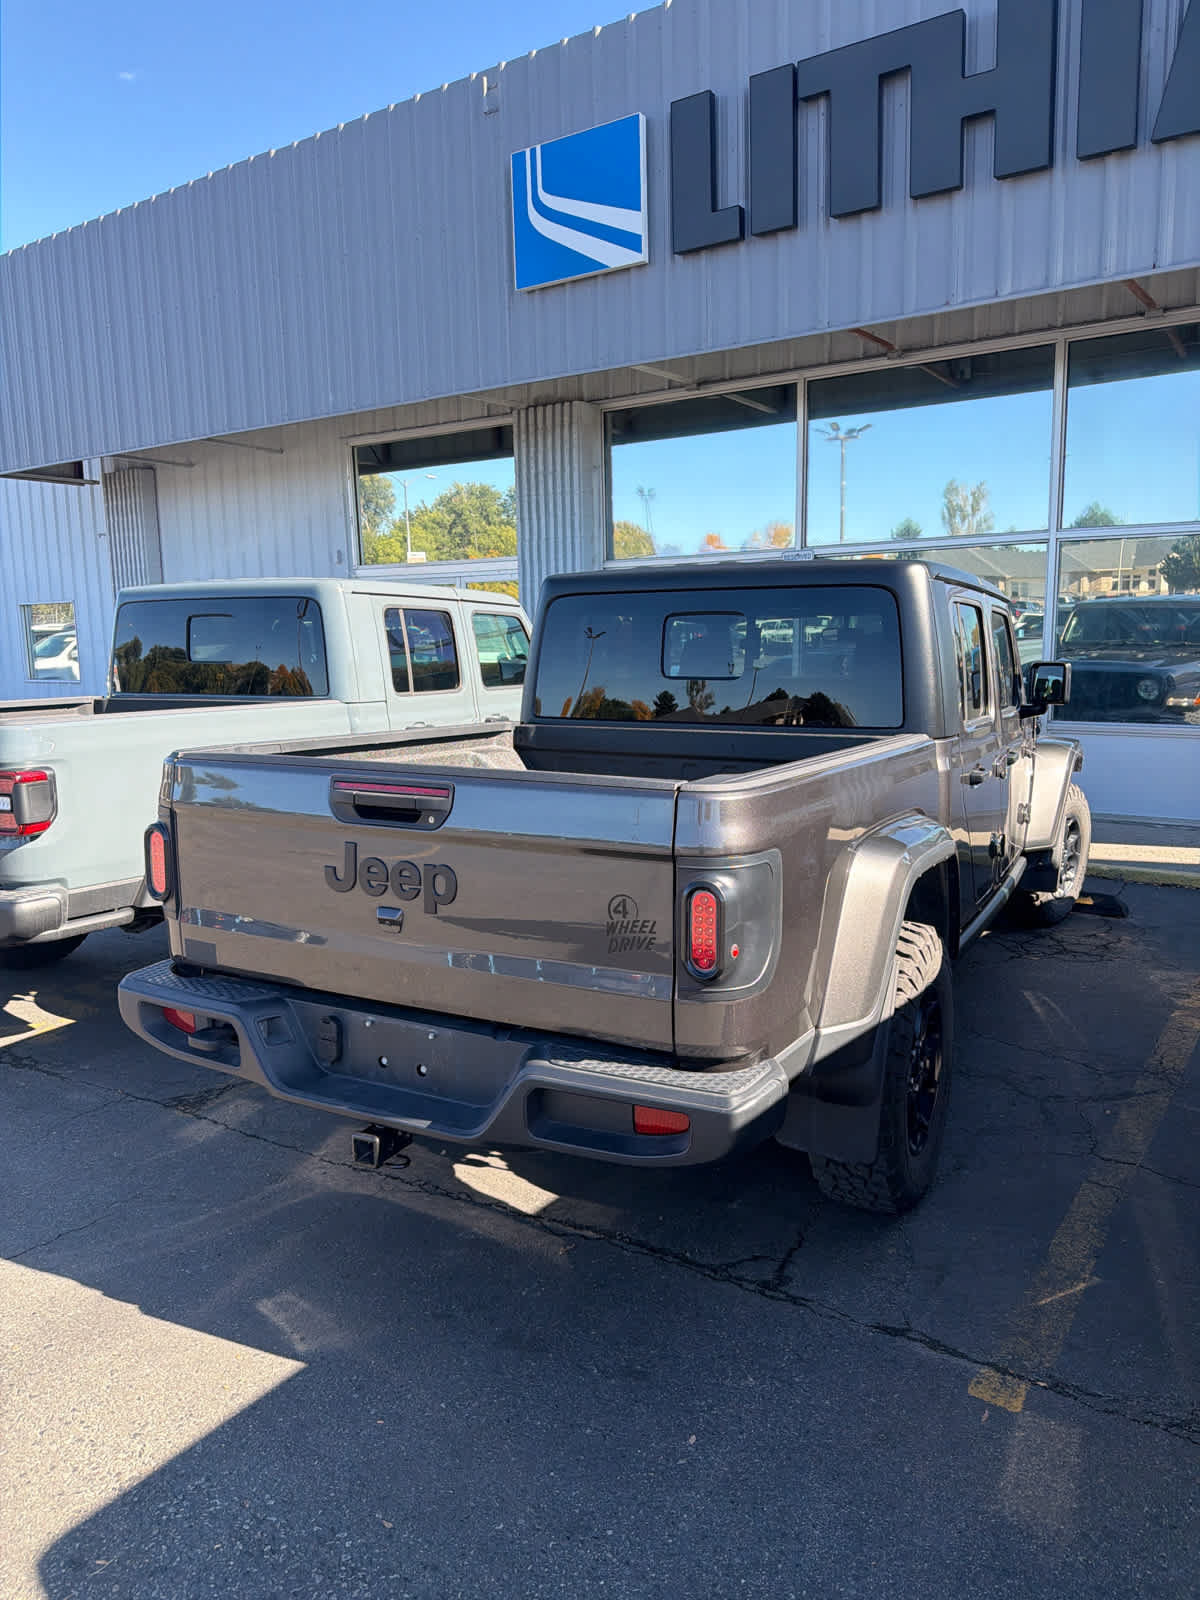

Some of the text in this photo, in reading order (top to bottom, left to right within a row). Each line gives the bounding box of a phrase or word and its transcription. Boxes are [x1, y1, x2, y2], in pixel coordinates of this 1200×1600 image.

[324, 841, 458, 914] Jeep
[611, 897, 631, 920] 4
[606, 919, 656, 936] WHEEL
[608, 935, 656, 953] DRIVE
